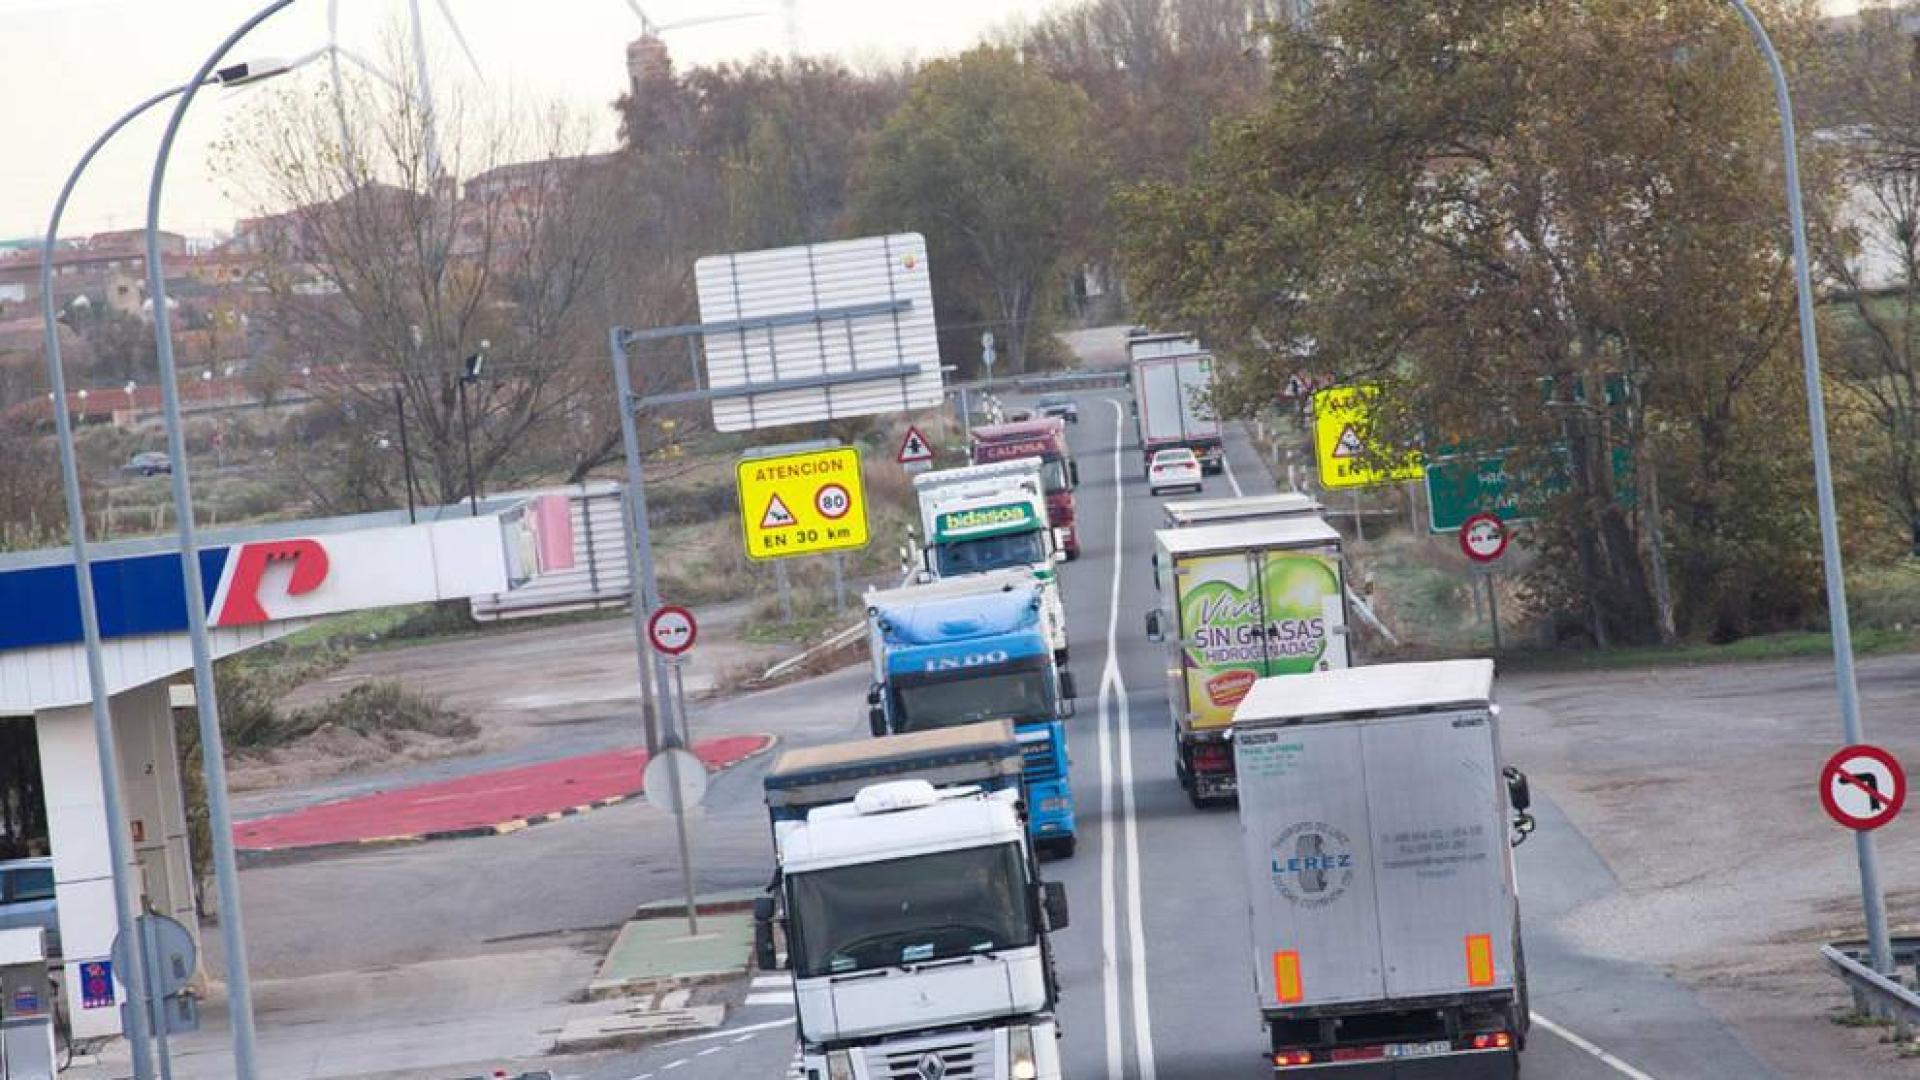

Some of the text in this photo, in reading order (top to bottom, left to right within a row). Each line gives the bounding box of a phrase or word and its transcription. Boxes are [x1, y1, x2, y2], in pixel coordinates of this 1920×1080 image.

[756, 459, 843, 481] ATENCION
[823, 495, 845, 509] 80
[946, 506, 1024, 530] bidasoa
[763, 527, 850, 548] EN 30 km
[1195, 626, 1230, 648] SIN
[1271, 853, 1352, 874] LEREZ
